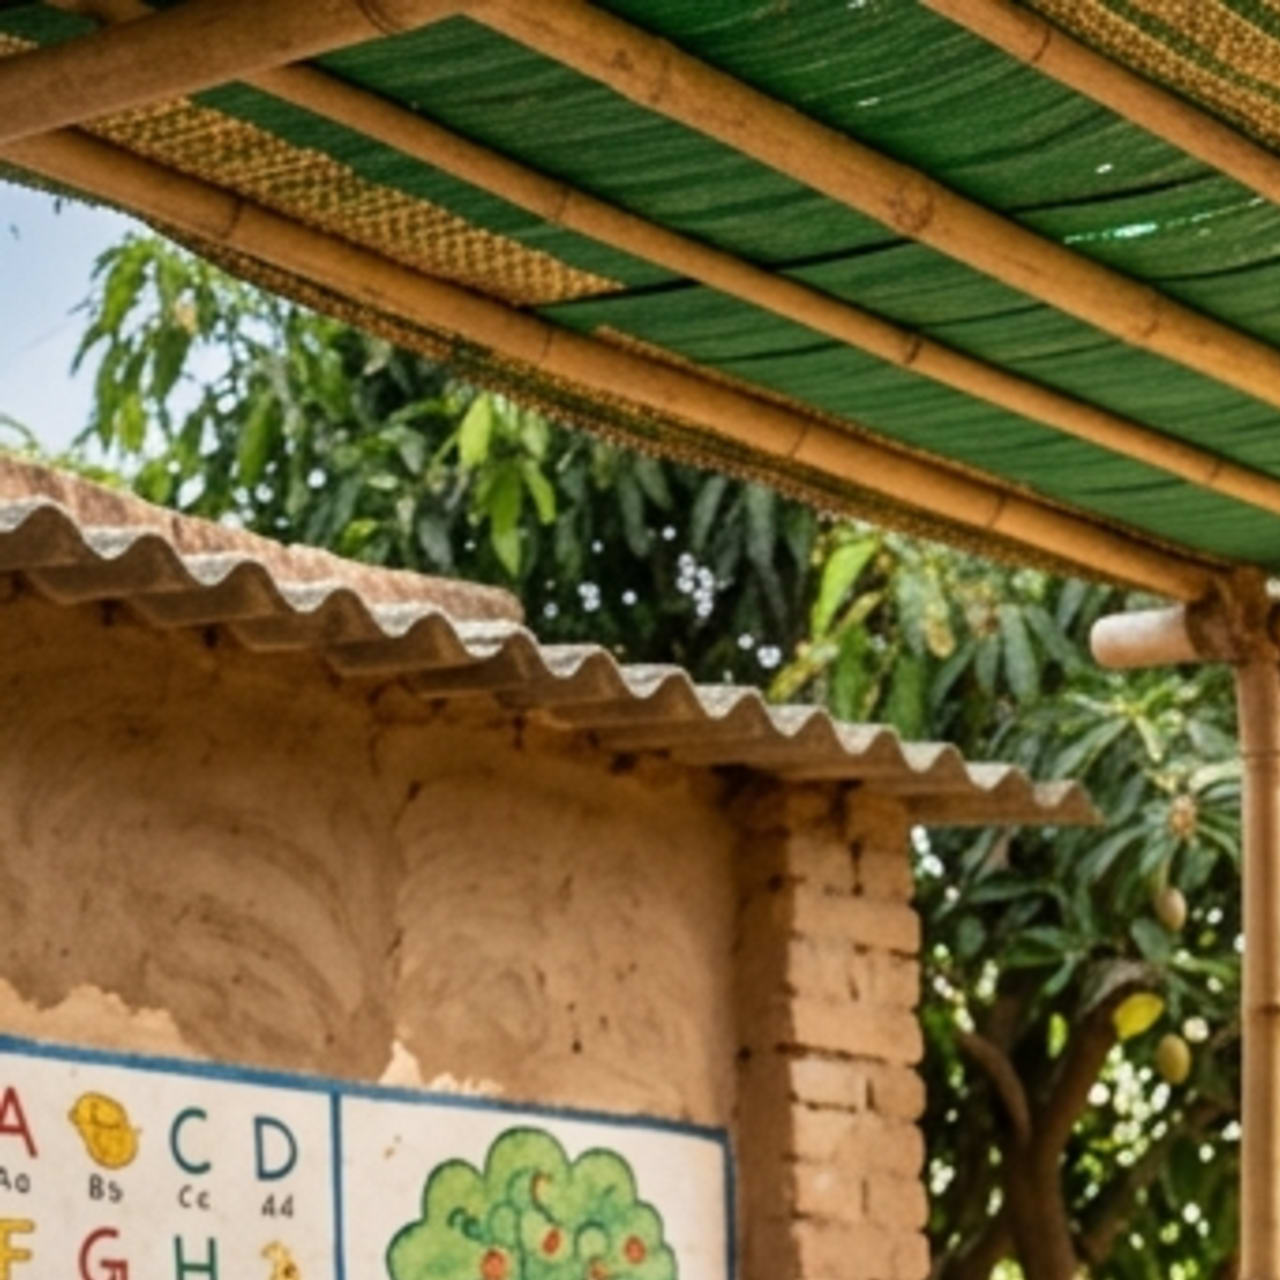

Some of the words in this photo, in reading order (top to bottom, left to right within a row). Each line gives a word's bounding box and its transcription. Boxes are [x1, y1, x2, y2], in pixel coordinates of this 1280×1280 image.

[0, 1087, 37, 1158] A
[170, 1108, 211, 1175] C
[254, 1116, 297, 1181] D
